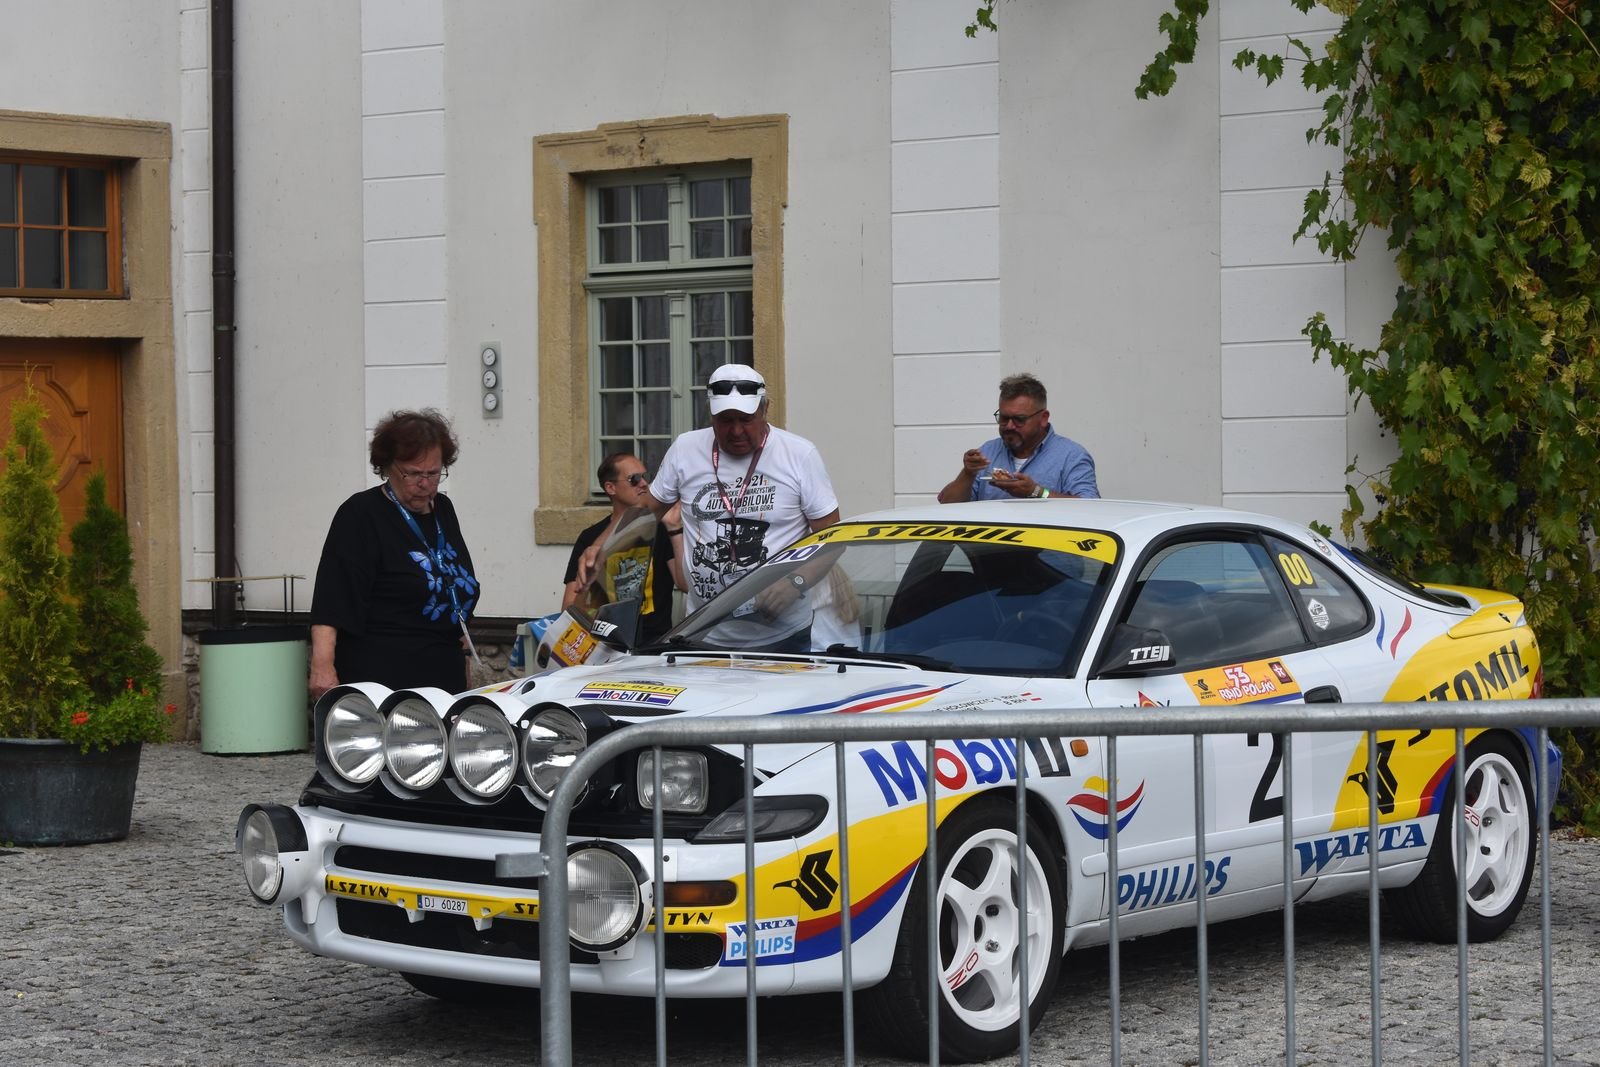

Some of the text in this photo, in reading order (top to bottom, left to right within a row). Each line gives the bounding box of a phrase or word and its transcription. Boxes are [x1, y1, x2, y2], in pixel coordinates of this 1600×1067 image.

[735, 474, 764, 488] 221
[854, 525, 1026, 543] STOMIL
[1279, 552, 1313, 586] 00
[1225, 665, 1250, 688] 53
[599, 690, 637, 700] Mobil
[1218, 687, 1241, 701] RAJD
[1243, 680, 1275, 696] POLSKI
[1247, 732, 1285, 823] 2
[1294, 823, 1427, 876] WARTA
[325, 879, 389, 898] LSZTYN
[424, 896, 467, 912] DJ 60287
